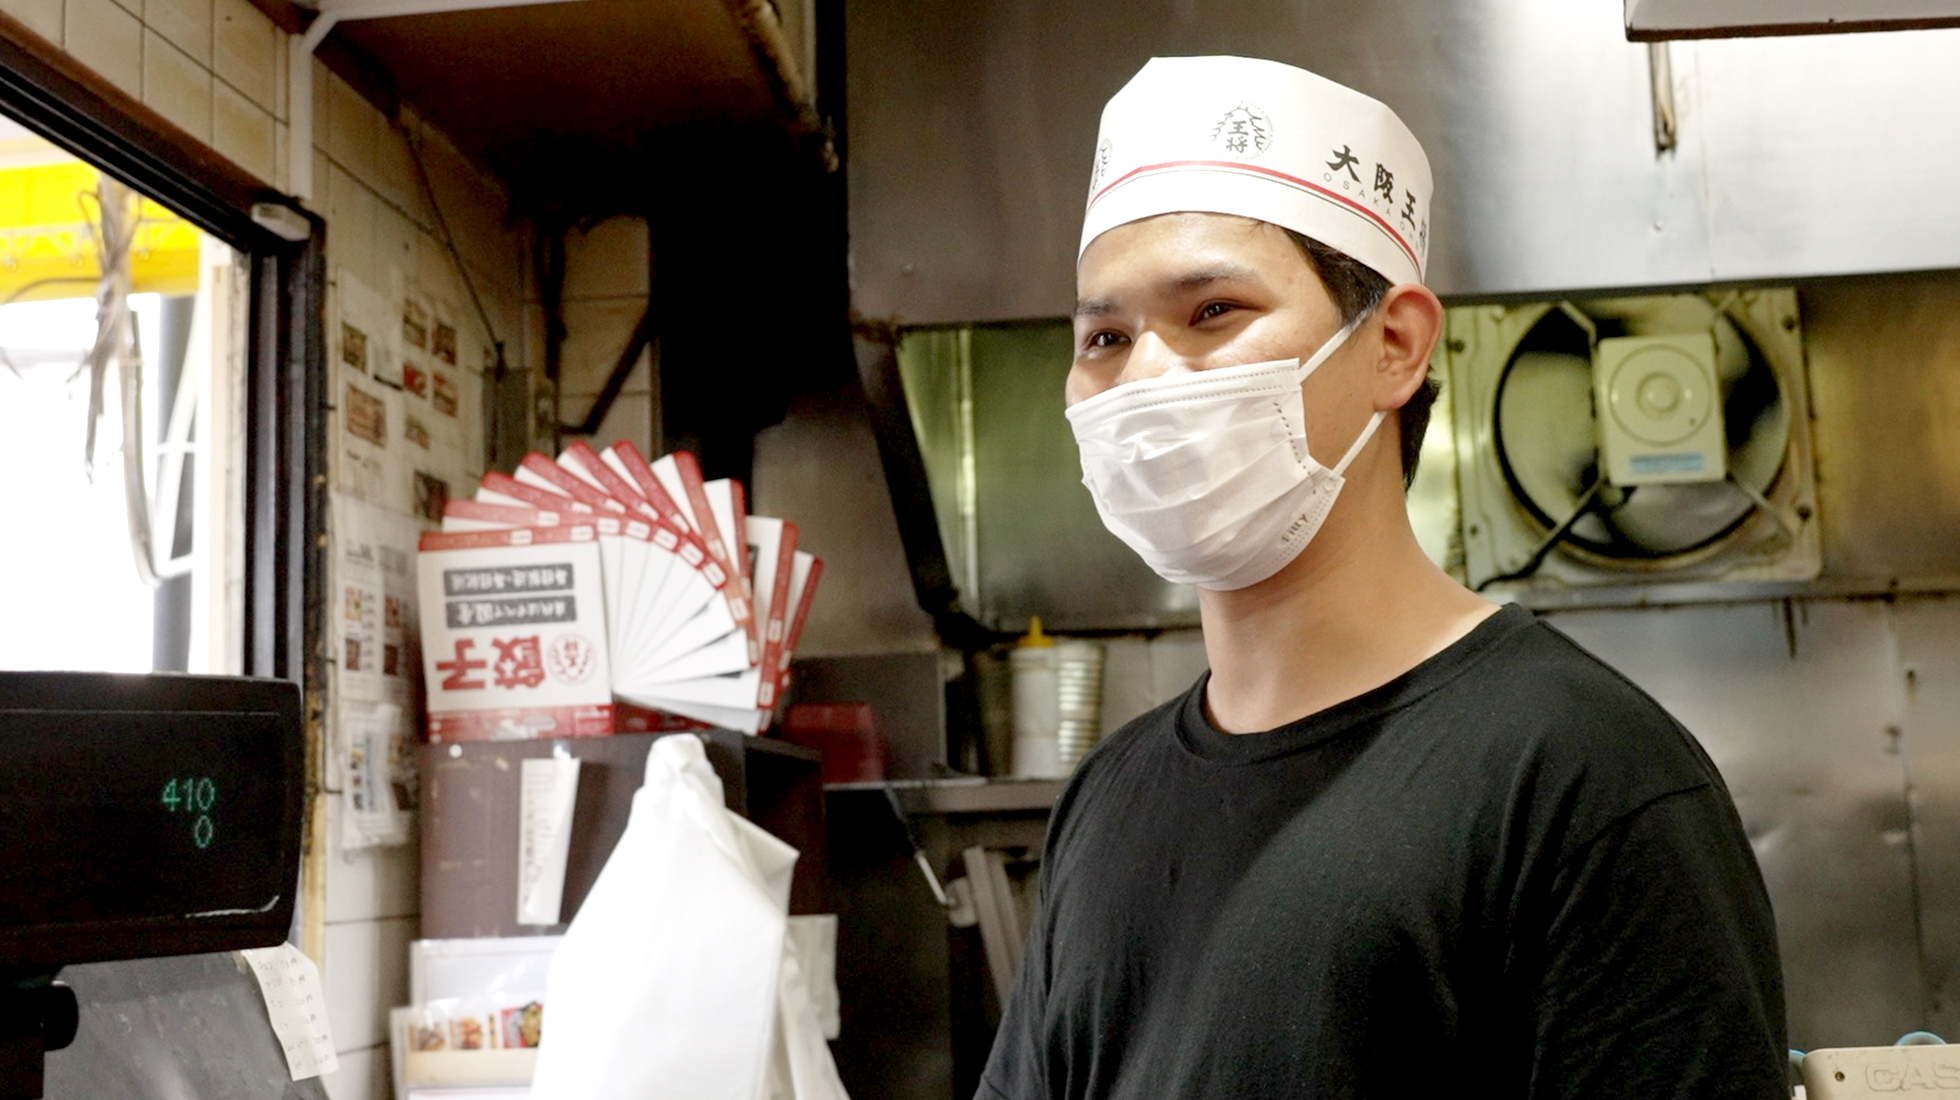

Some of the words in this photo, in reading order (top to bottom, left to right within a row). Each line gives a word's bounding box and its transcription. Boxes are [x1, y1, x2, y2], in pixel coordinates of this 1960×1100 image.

[1226, 120, 1249, 153] 王将
[1323, 172, 1391, 217] OSAKA
[436, 635, 546, 691] 餃子
[162, 778, 215, 811] 410
[194, 815, 213, 849] 0
